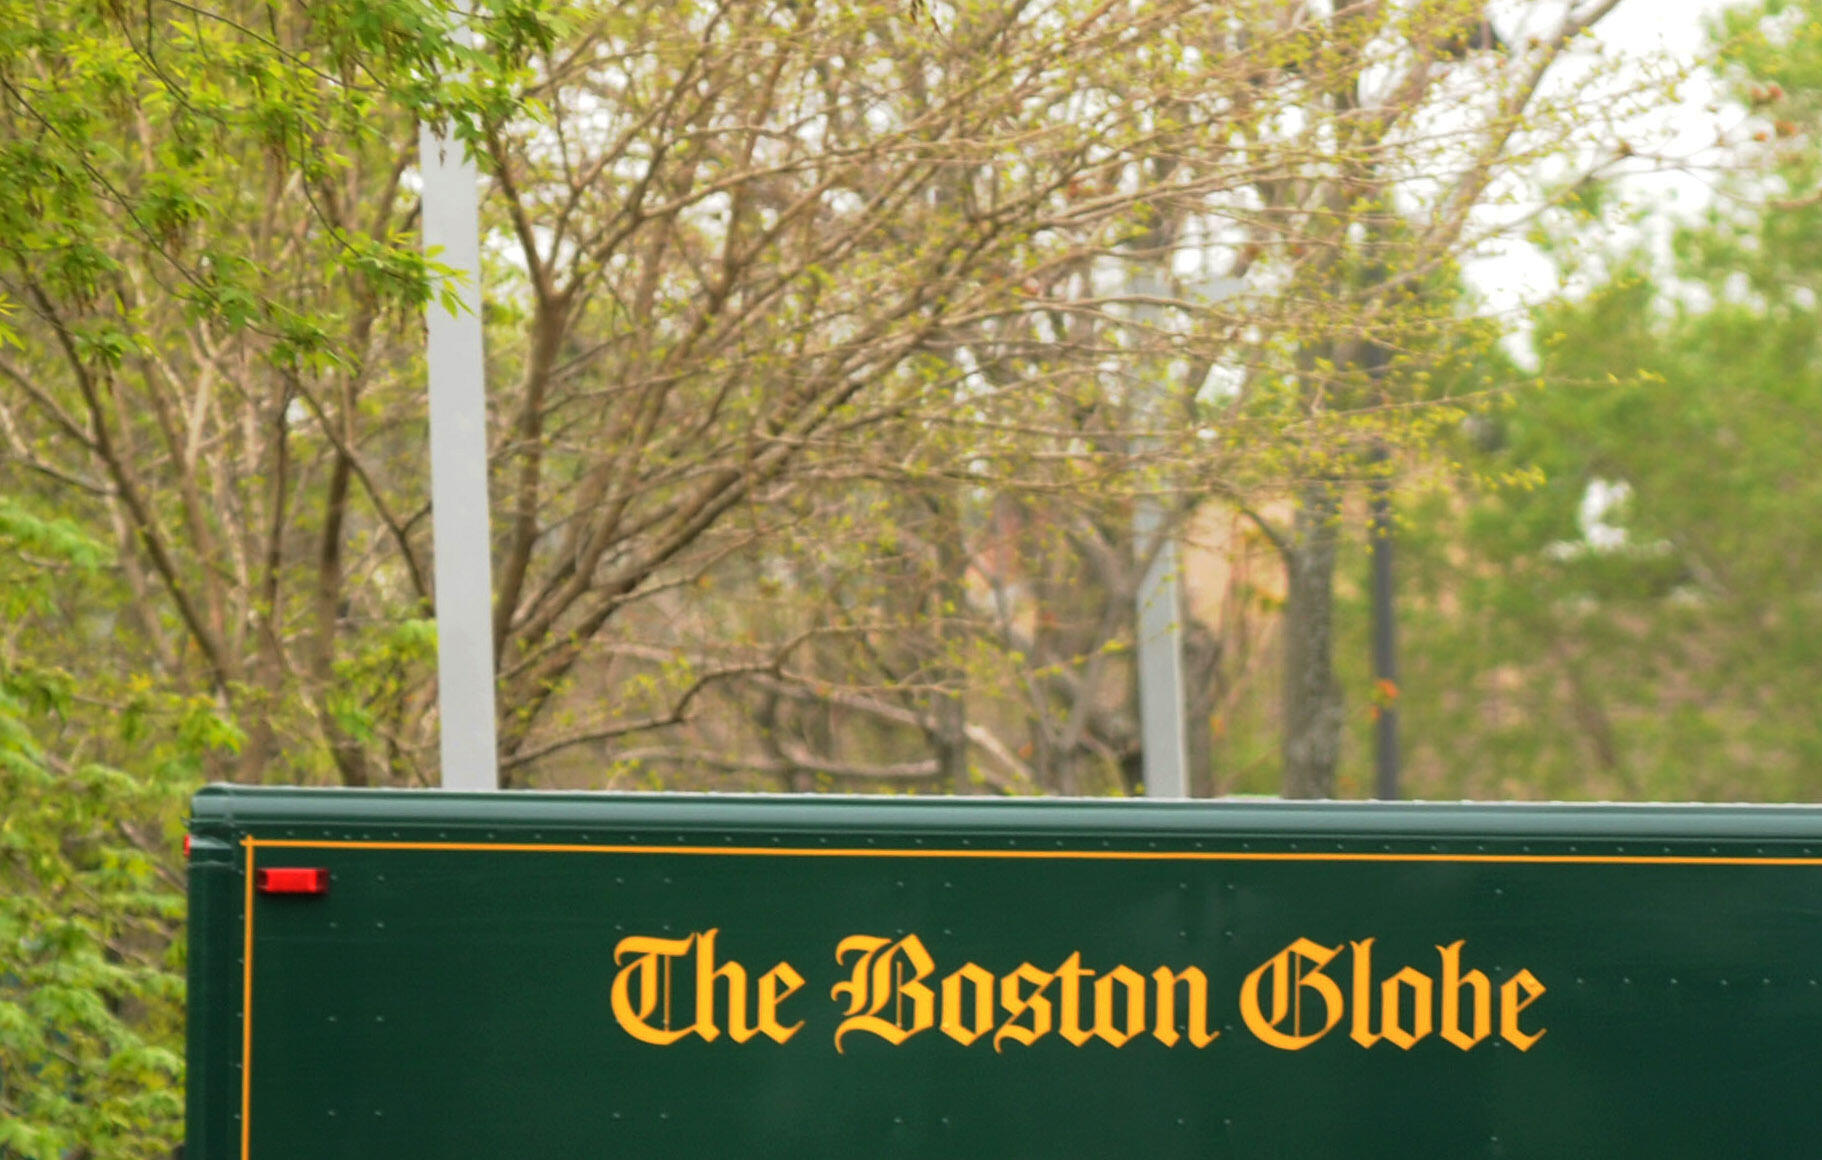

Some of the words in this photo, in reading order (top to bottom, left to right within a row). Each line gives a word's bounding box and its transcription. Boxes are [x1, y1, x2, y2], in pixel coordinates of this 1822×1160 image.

[611, 928, 806, 1045] The
[831, 934, 1219, 1054] Boston
[1239, 937, 1548, 1053] Globe
